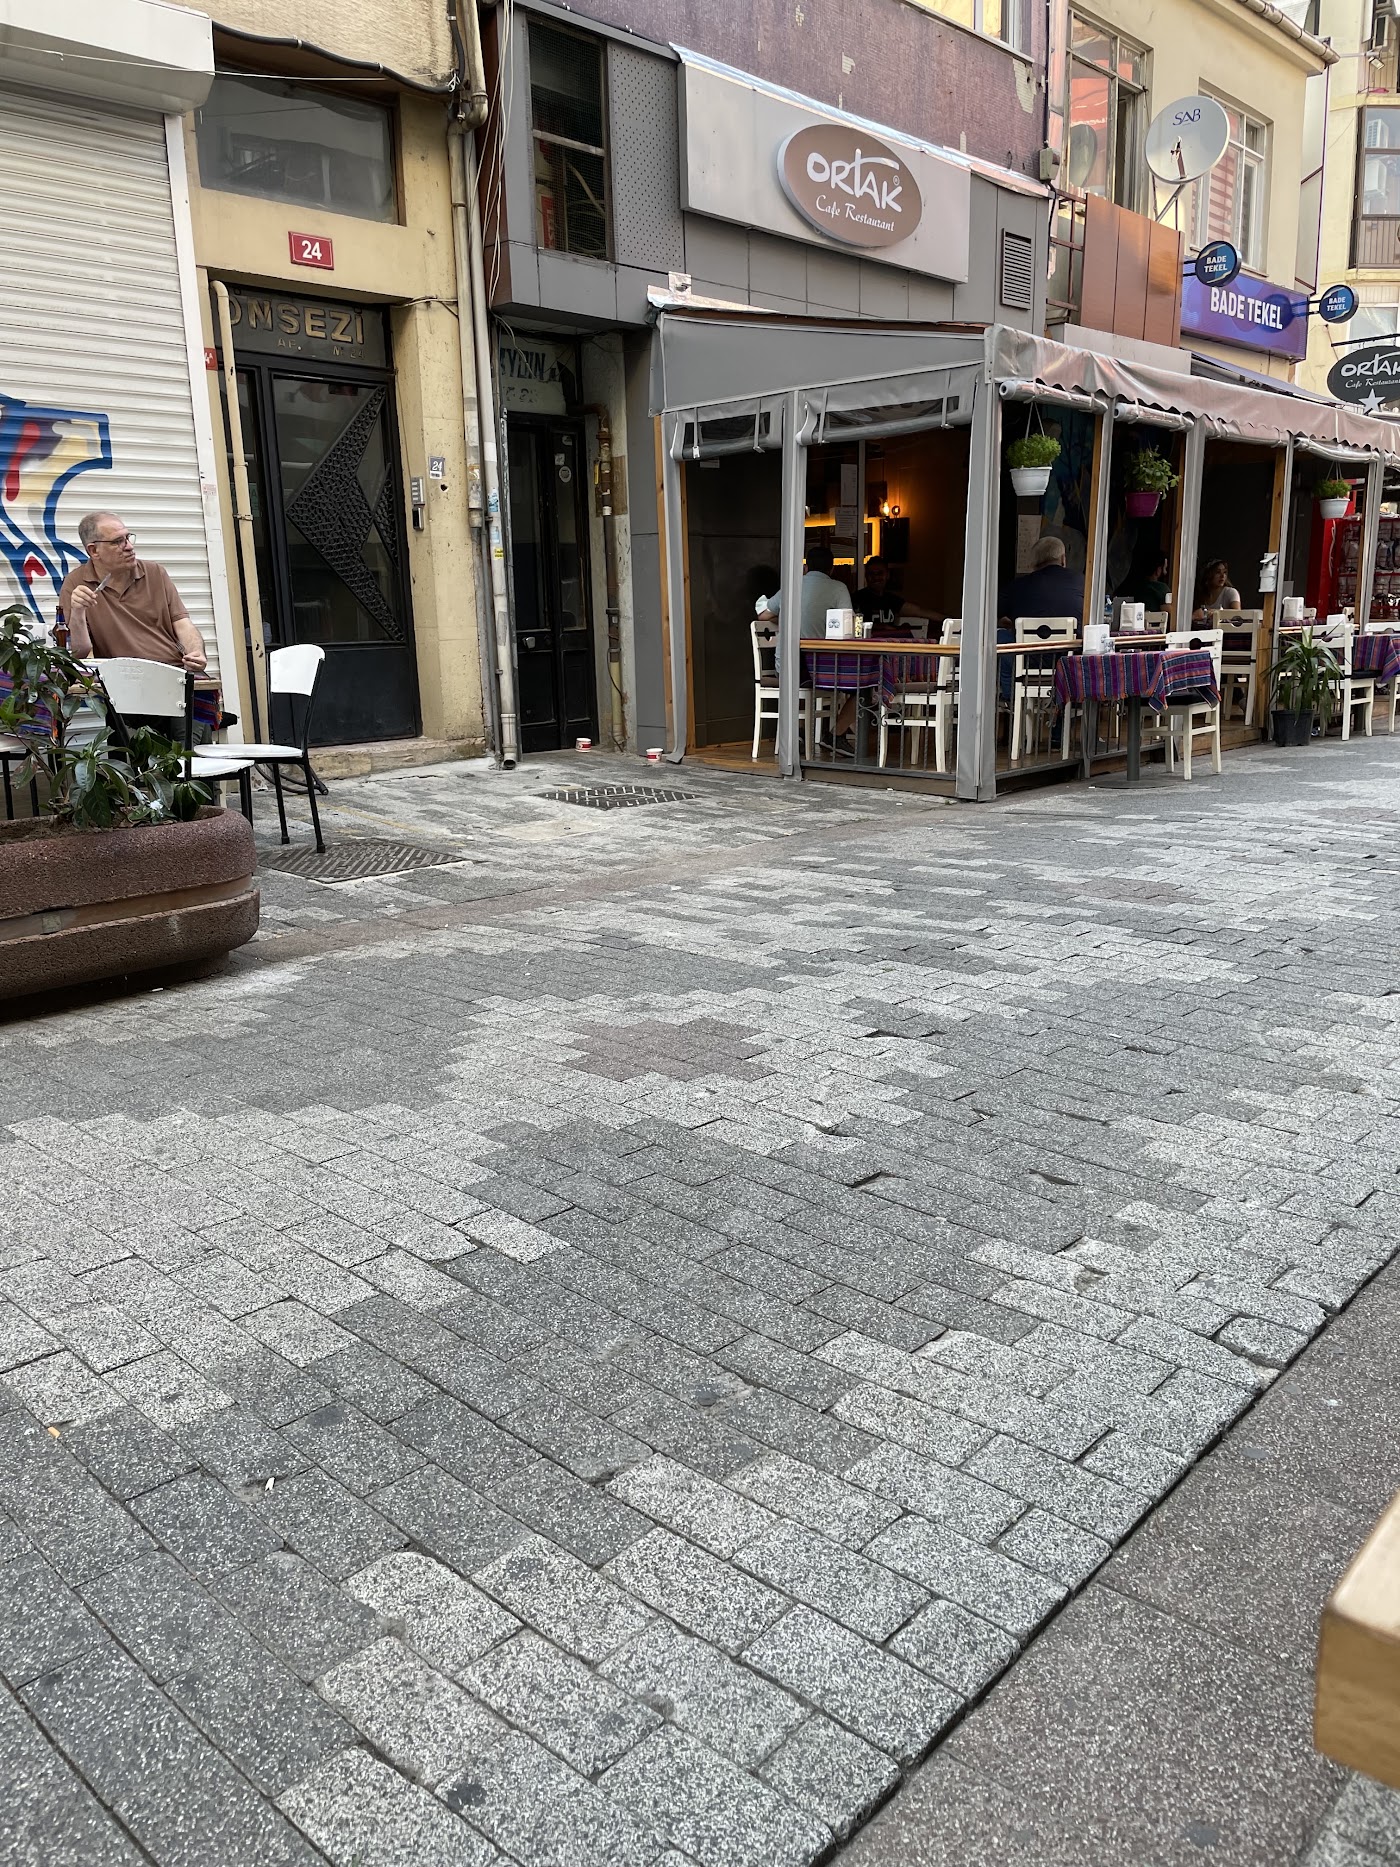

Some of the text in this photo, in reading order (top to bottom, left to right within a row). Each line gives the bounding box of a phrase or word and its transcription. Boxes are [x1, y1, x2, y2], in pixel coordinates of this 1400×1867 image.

[1172, 108, 1201, 126] SAB
[806, 148, 903, 213] ORTAK
[816, 195, 895, 232] Cafe Restaurant
[301, 240, 323, 260] 24
[1206, 255, 1227, 264] BADE
[1204, 263, 1228, 273] TEKEL
[1328, 296, 1346, 305] BADE
[1210, 286, 1283, 330] BADE TEKEL
[1326, 303, 1347, 312] TEKEL
[1345, 379, 1362, 389] Cafe
[431, 460, 443, 471] 24
